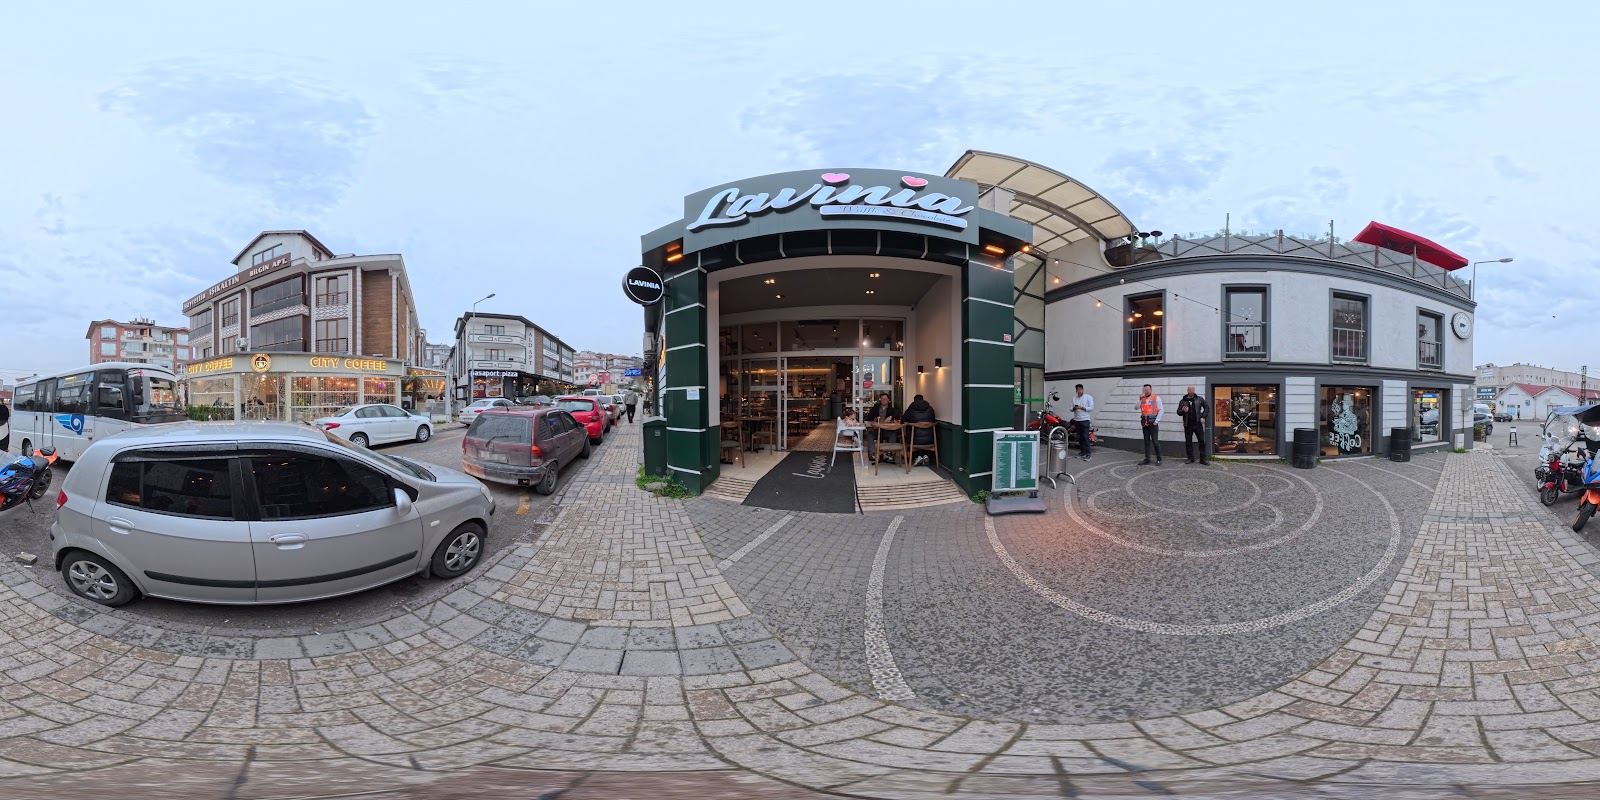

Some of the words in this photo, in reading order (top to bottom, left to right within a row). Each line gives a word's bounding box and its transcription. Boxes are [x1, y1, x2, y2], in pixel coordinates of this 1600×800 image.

[686, 173, 975, 230] Lavinia
[839, 205, 877, 214] Waffle
[628, 278, 661, 290] LAVINIA
[188, 363, 203, 374] CITY
[205, 358, 233, 372] COFFEE
[310, 357, 339, 369] CITY
[344, 358, 387, 371] COFFEE
